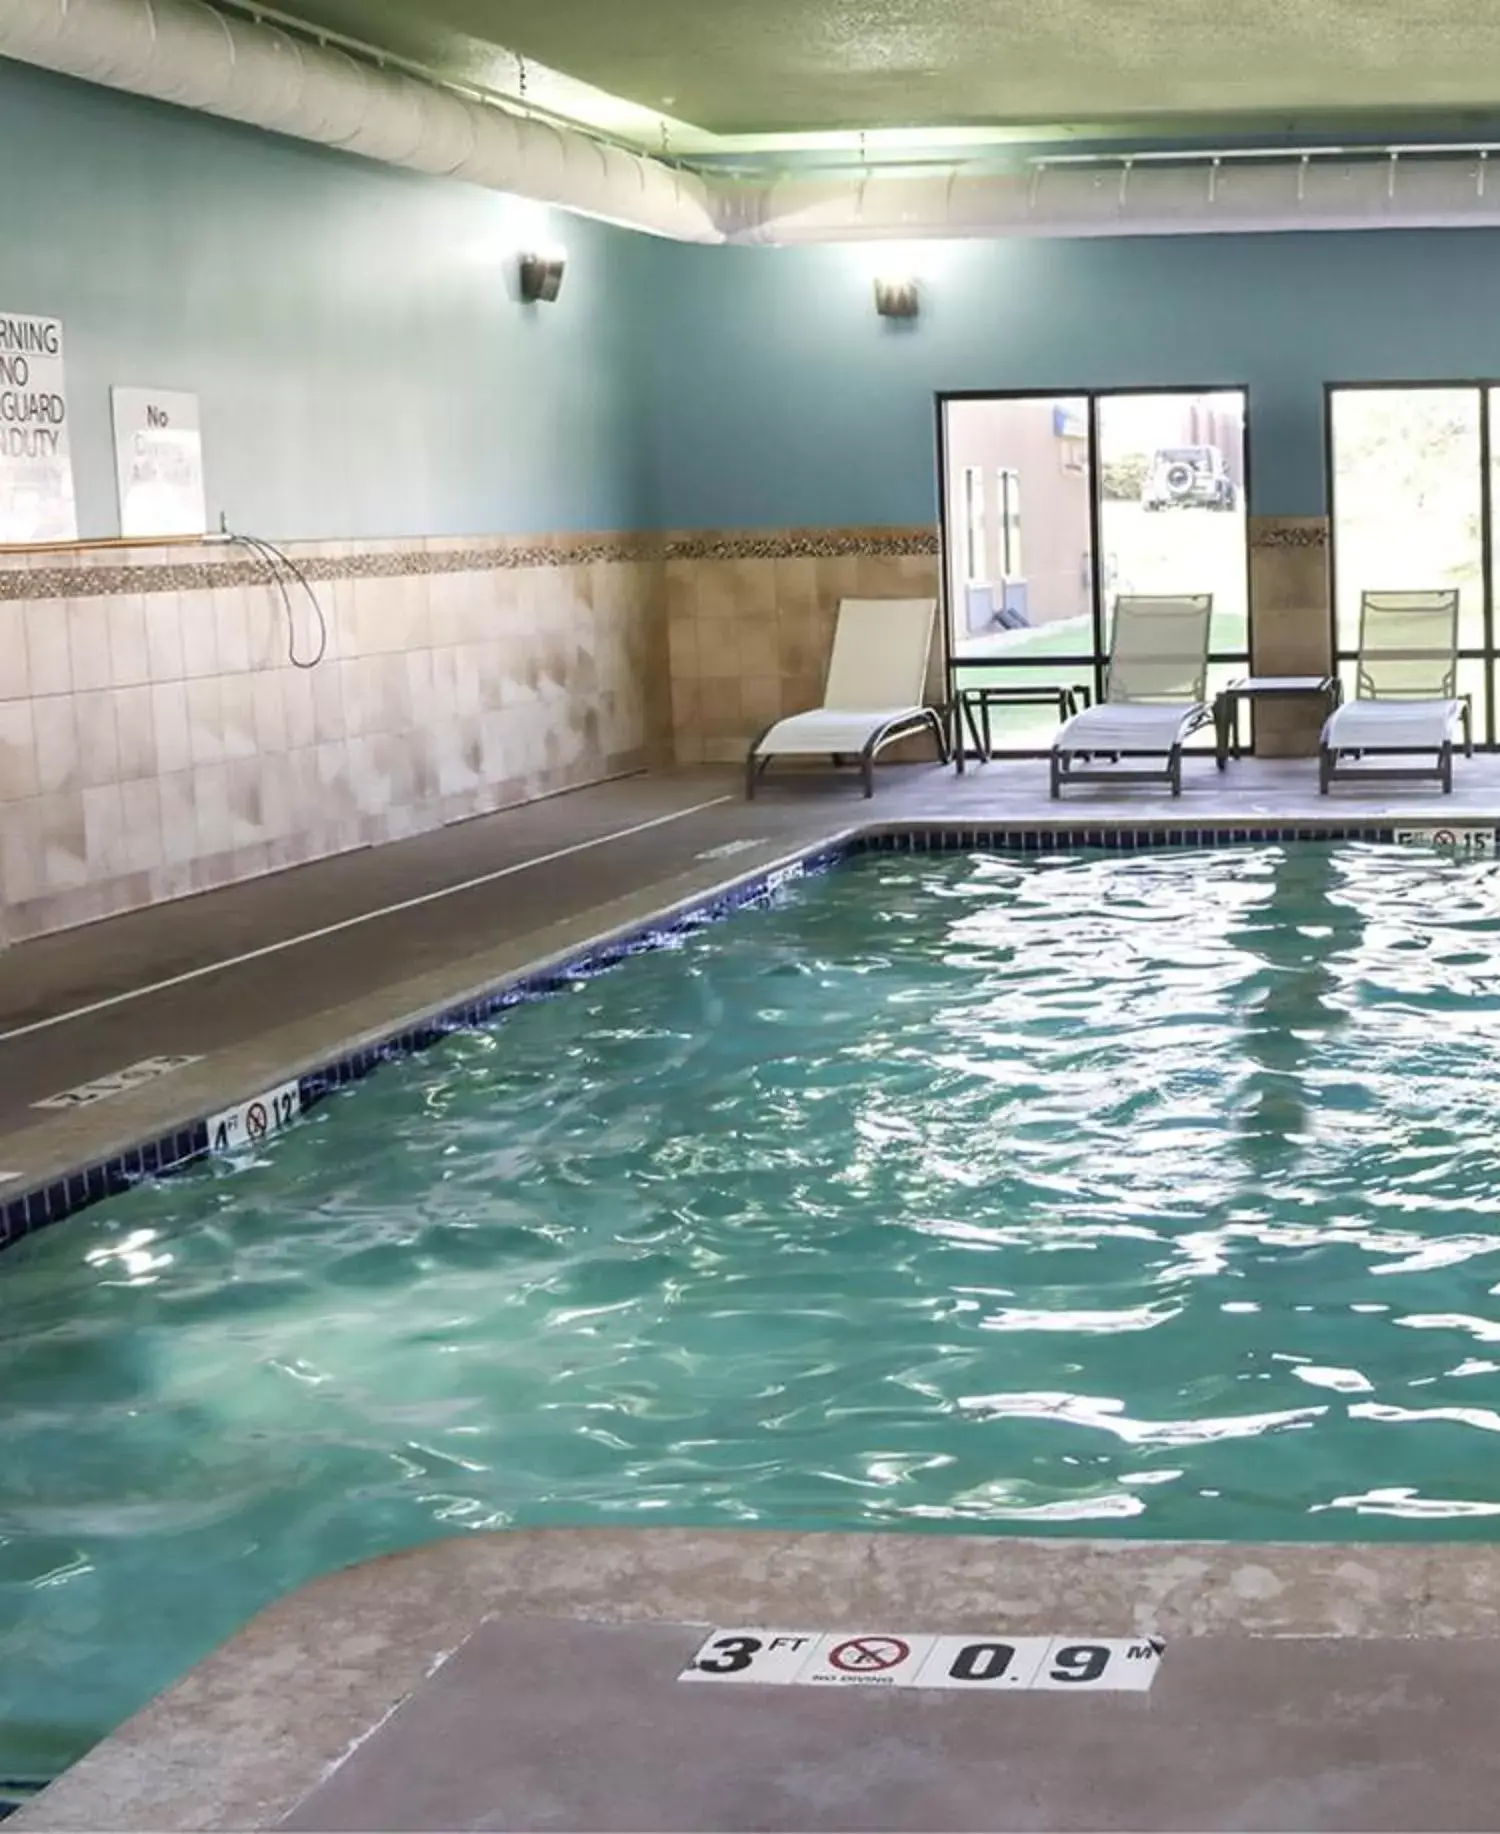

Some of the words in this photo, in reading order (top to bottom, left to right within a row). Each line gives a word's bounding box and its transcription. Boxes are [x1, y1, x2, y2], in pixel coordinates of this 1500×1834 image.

[0, 356, 28, 387] NO
[146, 404, 169, 428] No
[9, 427, 60, 457] DUTY
[701, 1637, 763, 1674] 3
[767, 1637, 809, 1652] FT
[840, 1674, 895, 1684] DIVING
